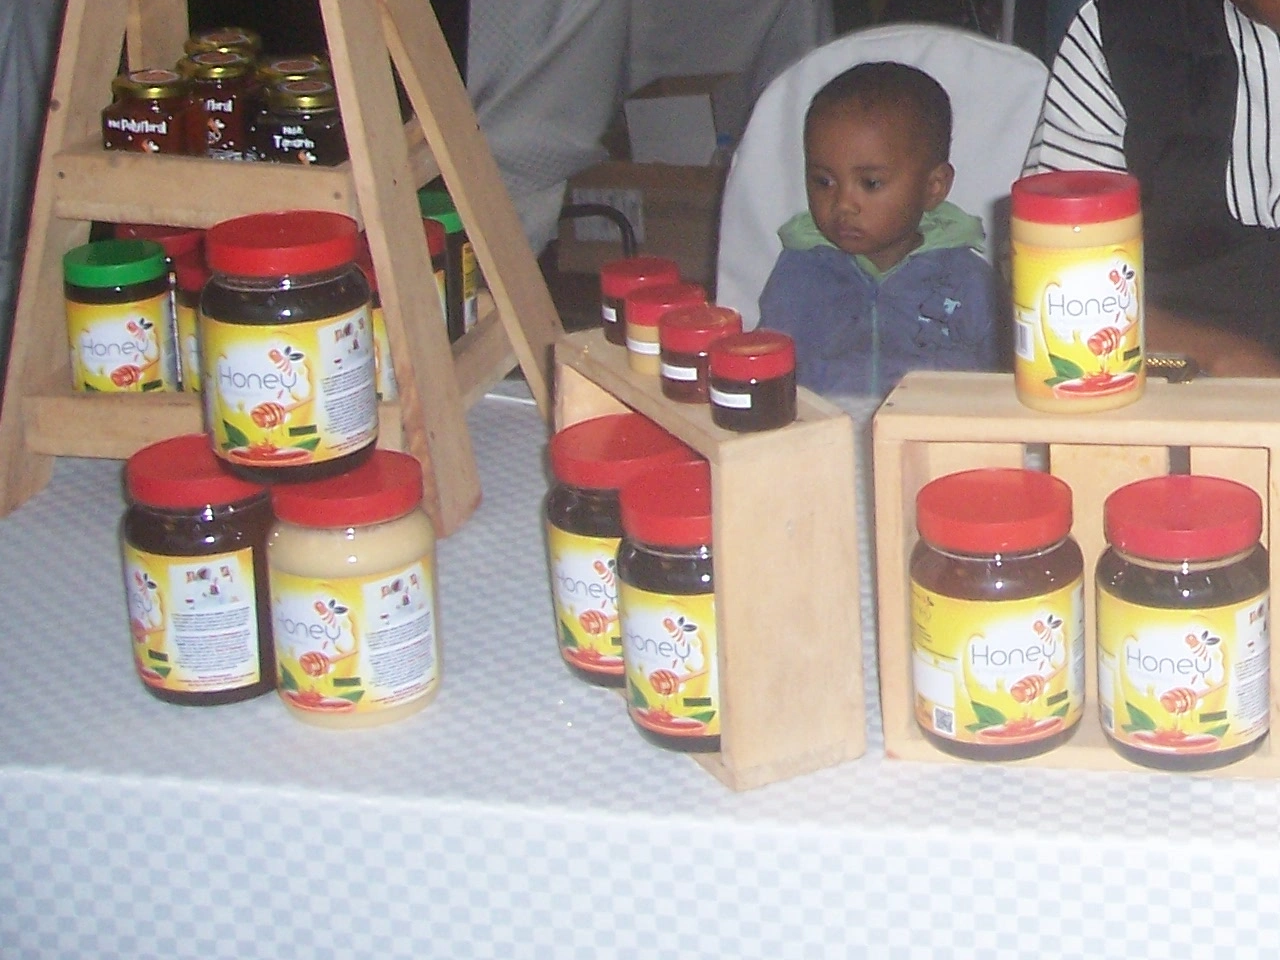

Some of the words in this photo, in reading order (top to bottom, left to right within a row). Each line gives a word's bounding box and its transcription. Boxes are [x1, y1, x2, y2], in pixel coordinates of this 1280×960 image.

[1047, 292, 1131, 317] Honey
[82, 338, 149, 357] Honey
[220, 361, 297, 394] Honey
[970, 642, 1057, 667] Honey
[1126, 648, 1212, 678] Honey
